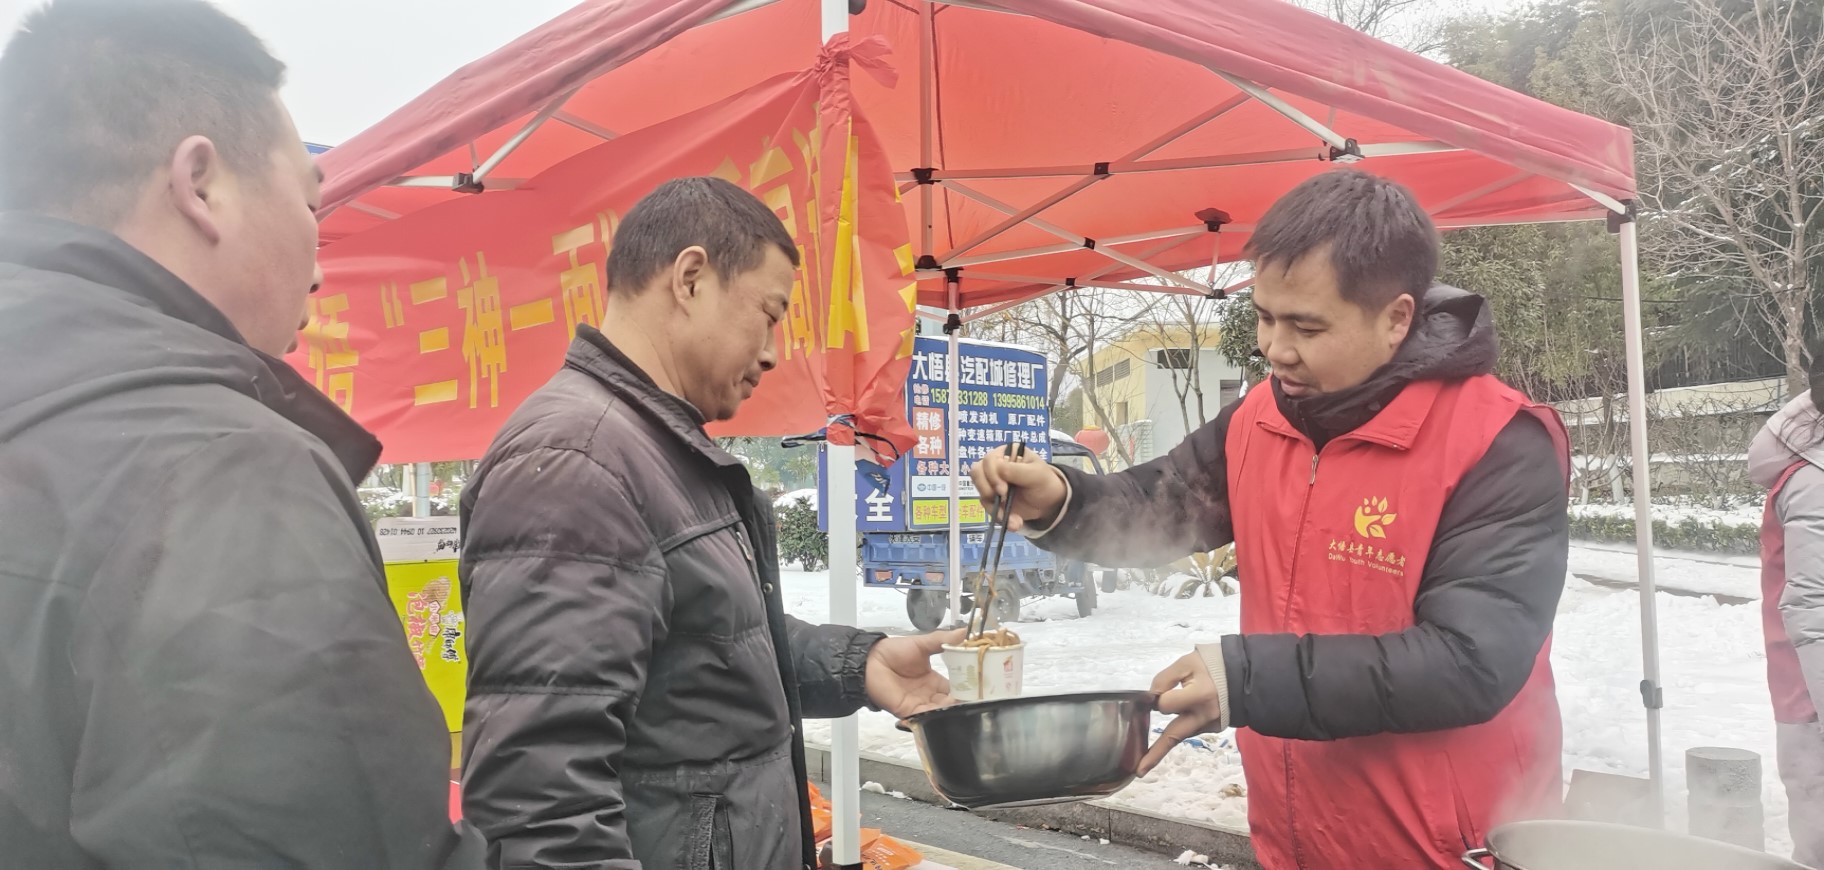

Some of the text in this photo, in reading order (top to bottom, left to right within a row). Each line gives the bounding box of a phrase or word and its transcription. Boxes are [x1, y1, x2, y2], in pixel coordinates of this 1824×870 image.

[930, 388, 1045, 410] 1587331288 13995861014
[915, 411, 942, 431] 精修
[948, 410, 1046, 428] 喷发动机 原厂配件
[916, 434, 943, 455] 各种
[948, 427, 1047, 444] 种变速箱原厂配件总成
[958, 504, 984, 518] 车配件
[1328, 538, 1406, 567] 大悟县青年志愿者
[1367, 560, 1404, 577] Volunteers
